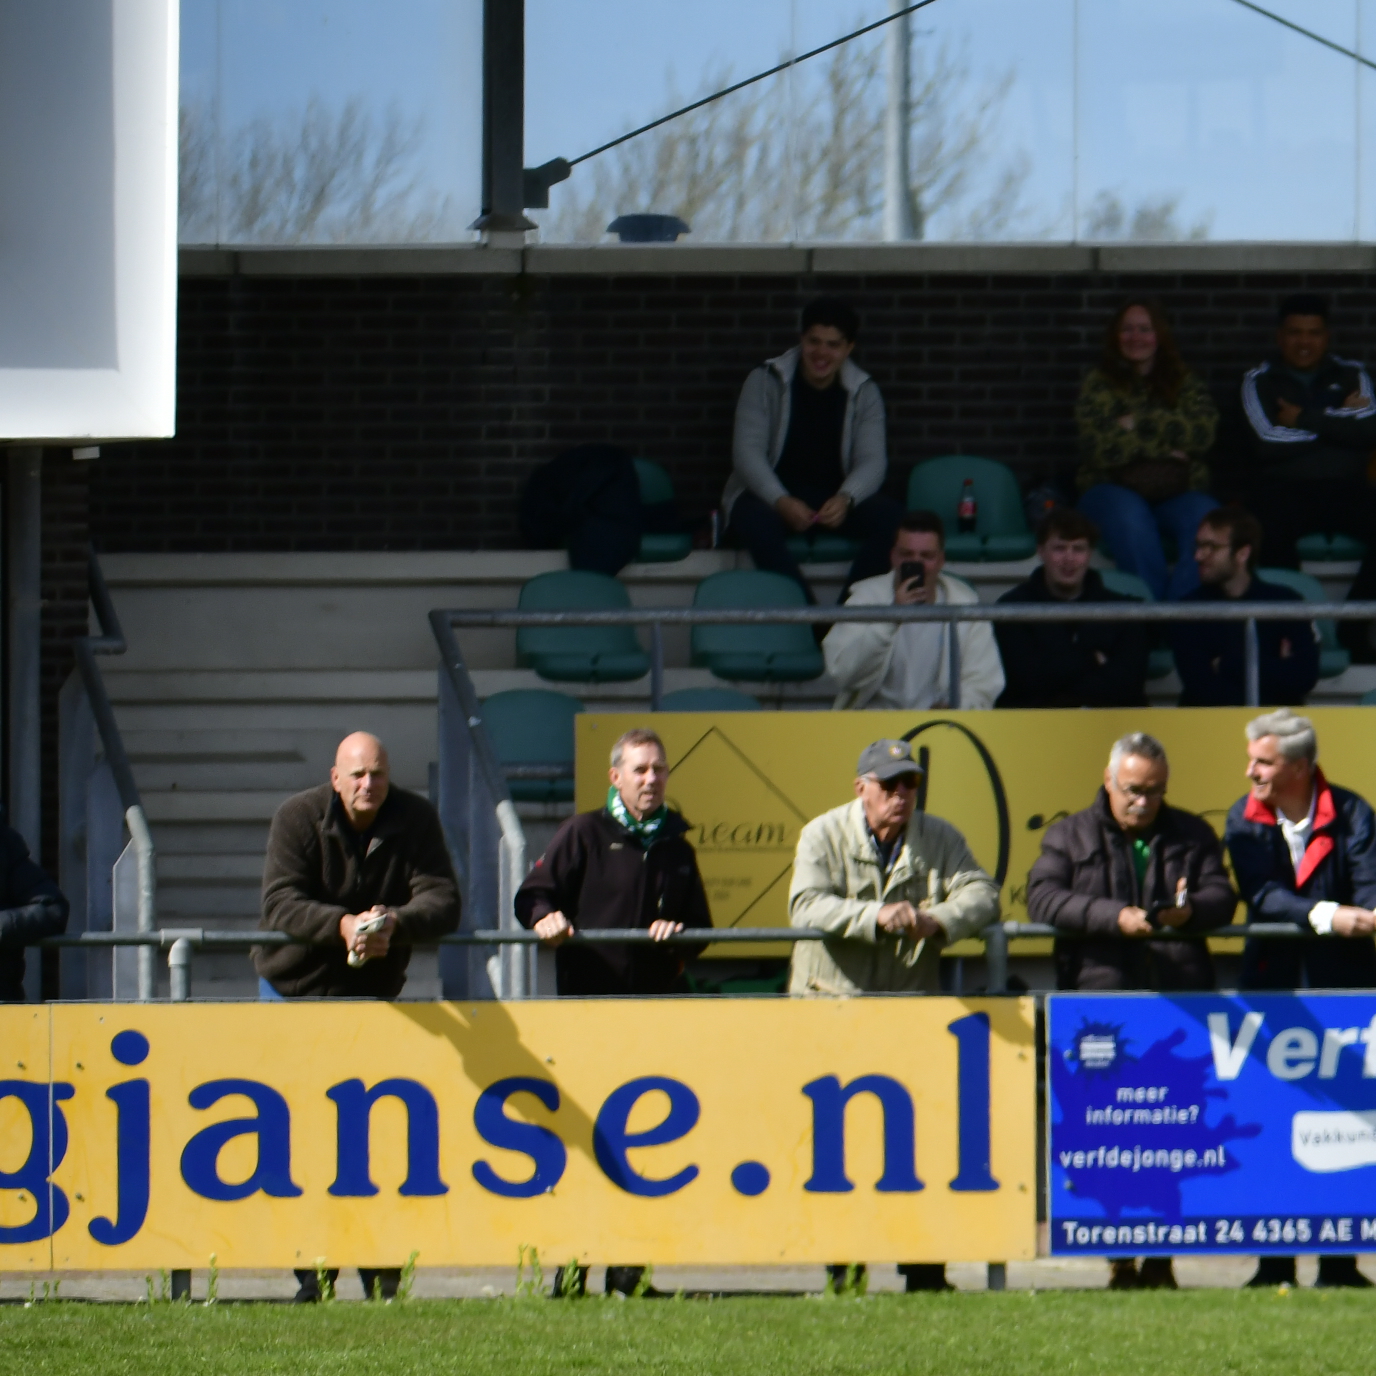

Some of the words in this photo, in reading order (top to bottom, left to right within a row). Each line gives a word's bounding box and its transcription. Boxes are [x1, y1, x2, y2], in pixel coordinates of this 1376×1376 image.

[1116, 1086, 1169, 1104] meer
[1085, 1104, 1200, 1126] informatie?
[1059, 1144, 1227, 1173] verfdejonge.nl
[1062, 1219, 1208, 1246] Torenstraat
[1215, 1219, 1245, 1245] 24
[1253, 1218, 1312, 1244] 4365
[1319, 1217, 1354, 1243] AE
